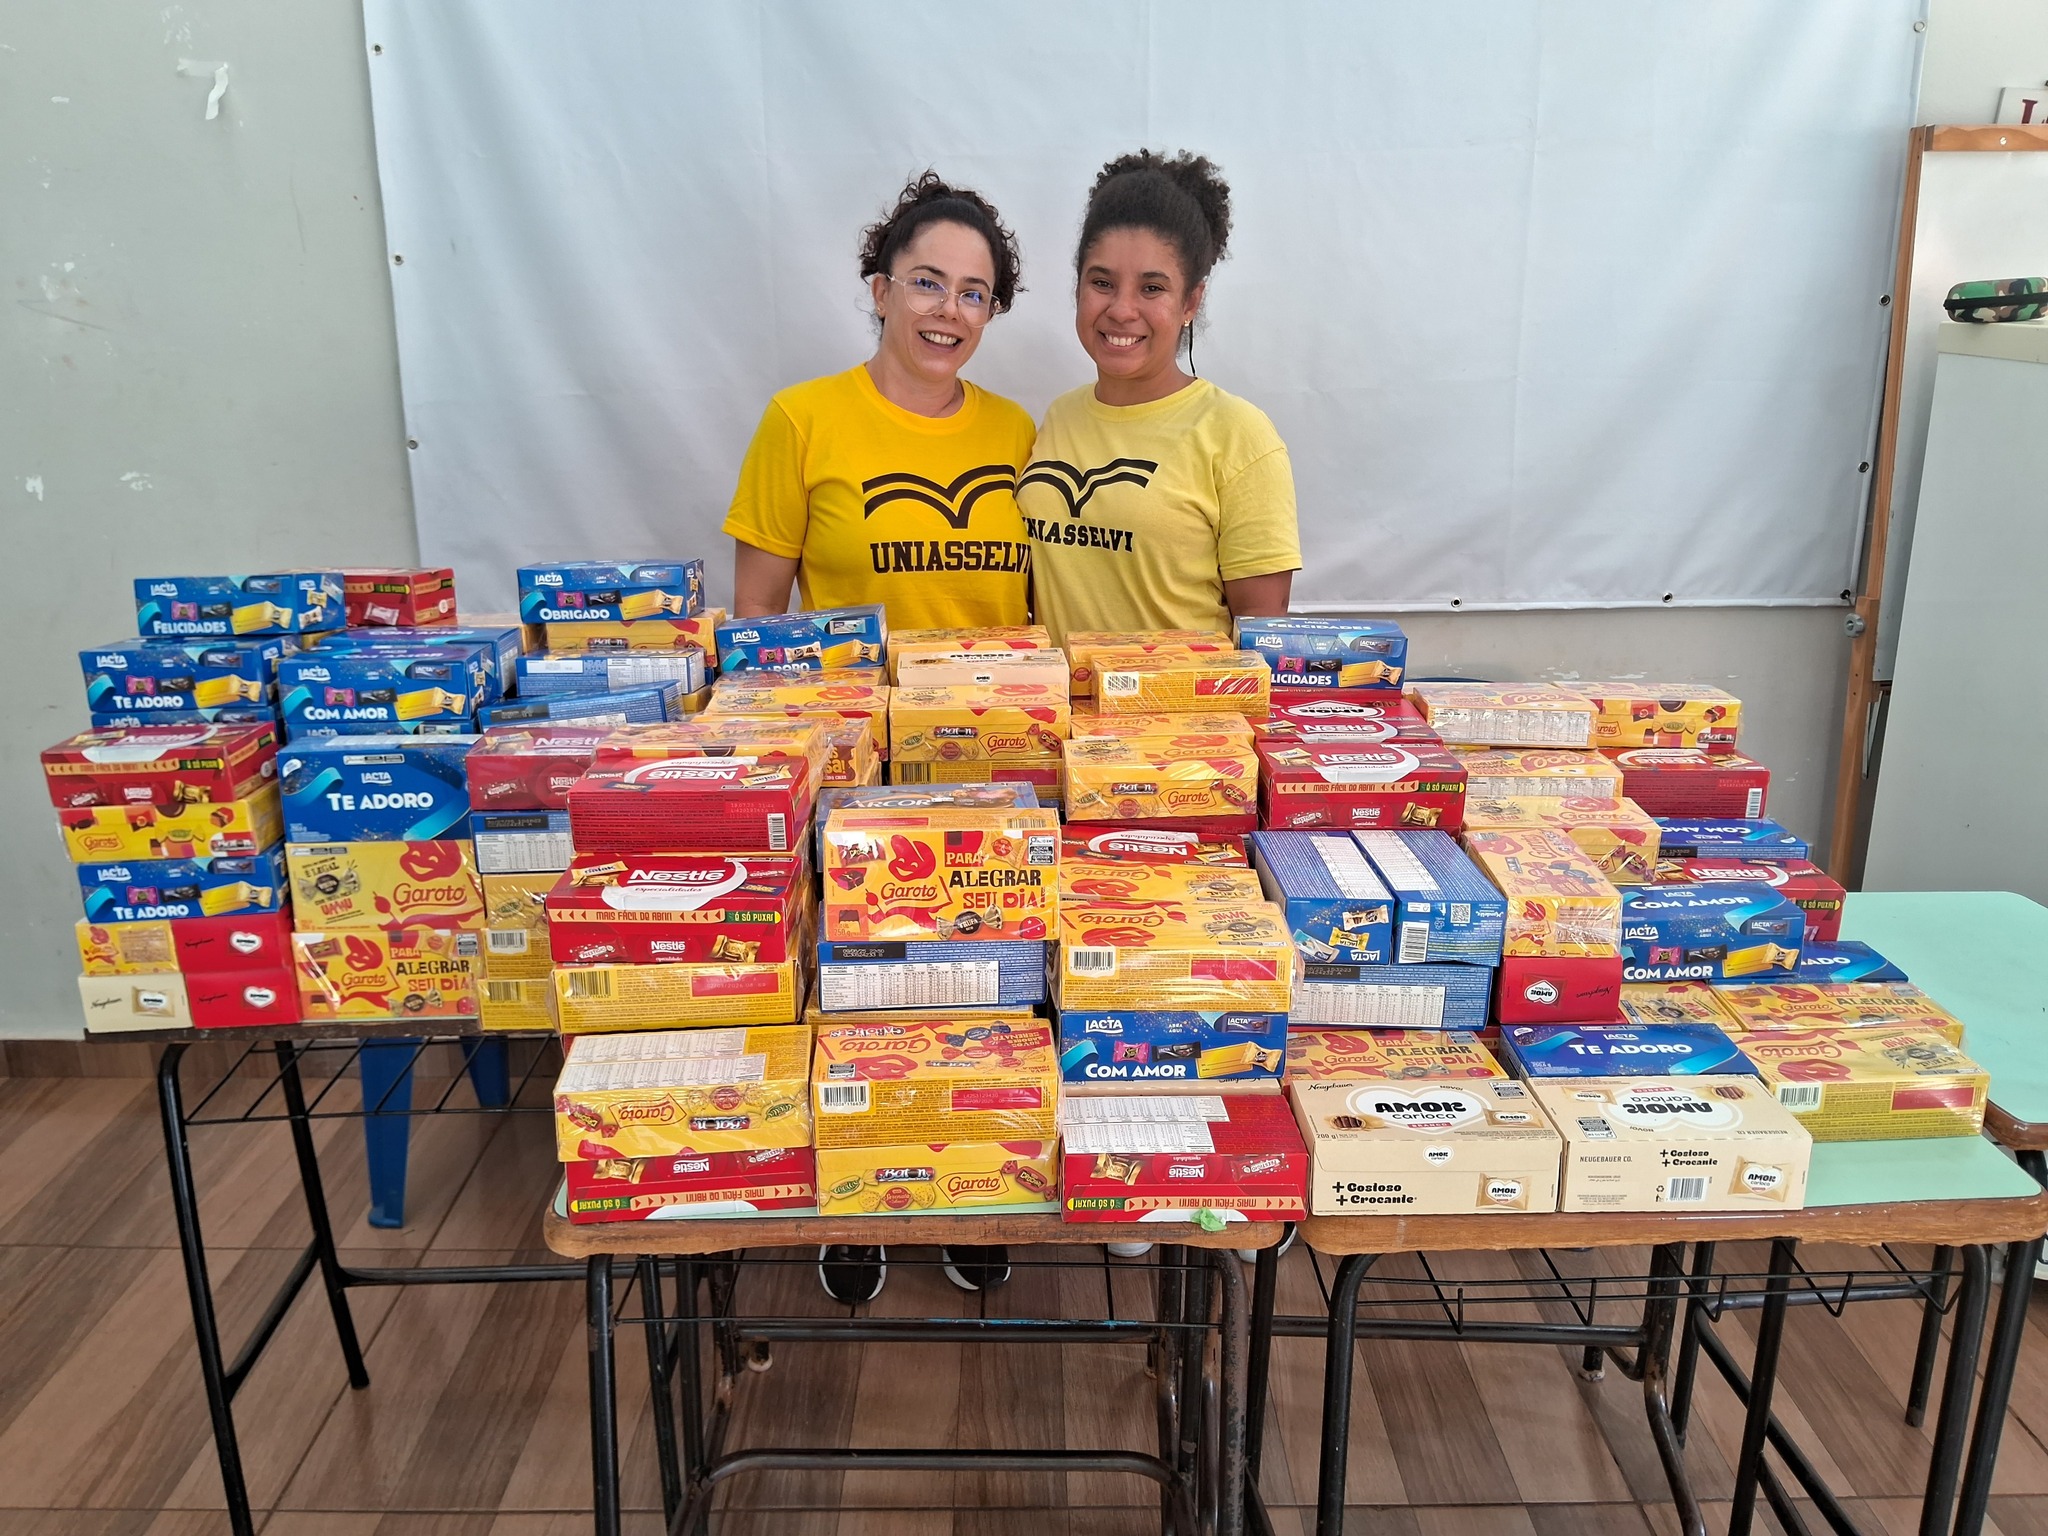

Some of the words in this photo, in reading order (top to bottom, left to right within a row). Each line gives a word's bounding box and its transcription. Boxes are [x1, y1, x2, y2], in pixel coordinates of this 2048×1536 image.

[870, 541, 1031, 574] UNIASSELVI
[535, 573, 563, 586] LACTA
[151, 582, 178, 597] LACTA
[540, 608, 610, 620] OBRIGADO
[154, 621, 226, 634] FELICIDADES
[732, 629, 760, 643] LACTA
[1256, 637, 1283, 648] LACTA
[97, 654, 128, 669] LACTA
[298, 668, 331, 681] LACTA
[1271, 674, 1332, 685] LICIDADES
[113, 696, 132, 708] TE
[135, 696, 184, 708] ADORO
[304, 706, 342, 720] COM
[345, 708, 388, 719] AMOR
[1303, 724, 1378, 733] Nestlé
[534, 737, 602, 749] Nestl
[987, 736, 1027, 750] Garoto
[1319, 753, 1397, 764] Nestlé
[361, 772, 392, 784] LACTA
[646, 769, 736, 780] Nestlé
[327, 794, 355, 811] TE
[360, 793, 434, 810] ADORO
[1352, 808, 1381, 819] Nestlé
[1108, 842, 1187, 855] Nestlé
[946, 852, 983, 864] PARA
[98, 866, 131, 881] LACTA
[627, 869, 725, 884] Nestlé
[950, 869, 1041, 888] ALEGRAR
[1072, 869, 1150, 880] Garoto
[1689, 868, 1770, 880] Nestlé
[393, 883, 467, 909] Garoto
[880, 883, 938, 904] Garoto
[963, 892, 997, 909] SEU
[1630, 901, 1685, 909] COM
[1688, 897, 1752, 906] AMOR
[113, 908, 134, 920] TE
[137, 905, 189, 918] ADORO
[596, 911, 616, 921] MAIS
[742, 911, 751, 922] SÓ
[1078, 913, 1165, 927] Garoto
[1625, 925, 1658, 940] LACTA
[391, 948, 421, 958] PARA
[651, 941, 685, 954] Nestlé
[1351, 950, 1380, 961] LACTA
[396, 960, 469, 975] ALEGRAR
[1624, 967, 1661, 980] COM
[1665, 966, 1713, 977] AMOR
[342, 973, 387, 989] Garoto
[409, 979, 437, 991] SEU
[1085, 1017, 1123, 1034] LACTA
[1227, 1017, 1249, 1025] LACTA
[840, 1038, 931, 1054] Garoto
[1386, 1046, 1472, 1056] ALEGRAR
[1569, 1044, 1603, 1055] TE
[1610, 1044, 1693, 1054] ADORO
[1758, 1042, 1842, 1058] Garoto
[1325, 1054, 1378, 1067] Garoto
[1403, 1057, 1436, 1066] SEU
[1085, 1064, 1127, 1078] COM
[1132, 1063, 1186, 1077] AMOR
[1308, 1083, 1354, 1091] Neugebauer
[619, 1103, 675, 1120] Garoto
[1374, 1102, 1466, 1113] AMOR
[1623, 1103, 1713, 1114] AMOR
[673, 1159, 709, 1174] Nestlé
[1168, 1164, 1204, 1179] Nestlé
[1747, 1174, 1776, 1182] AMOR
[948, 1177, 1001, 1197] Garoto
[1098, 1199, 1108, 1210] SÓ
[1236, 1198, 1257, 1208] MAIS
